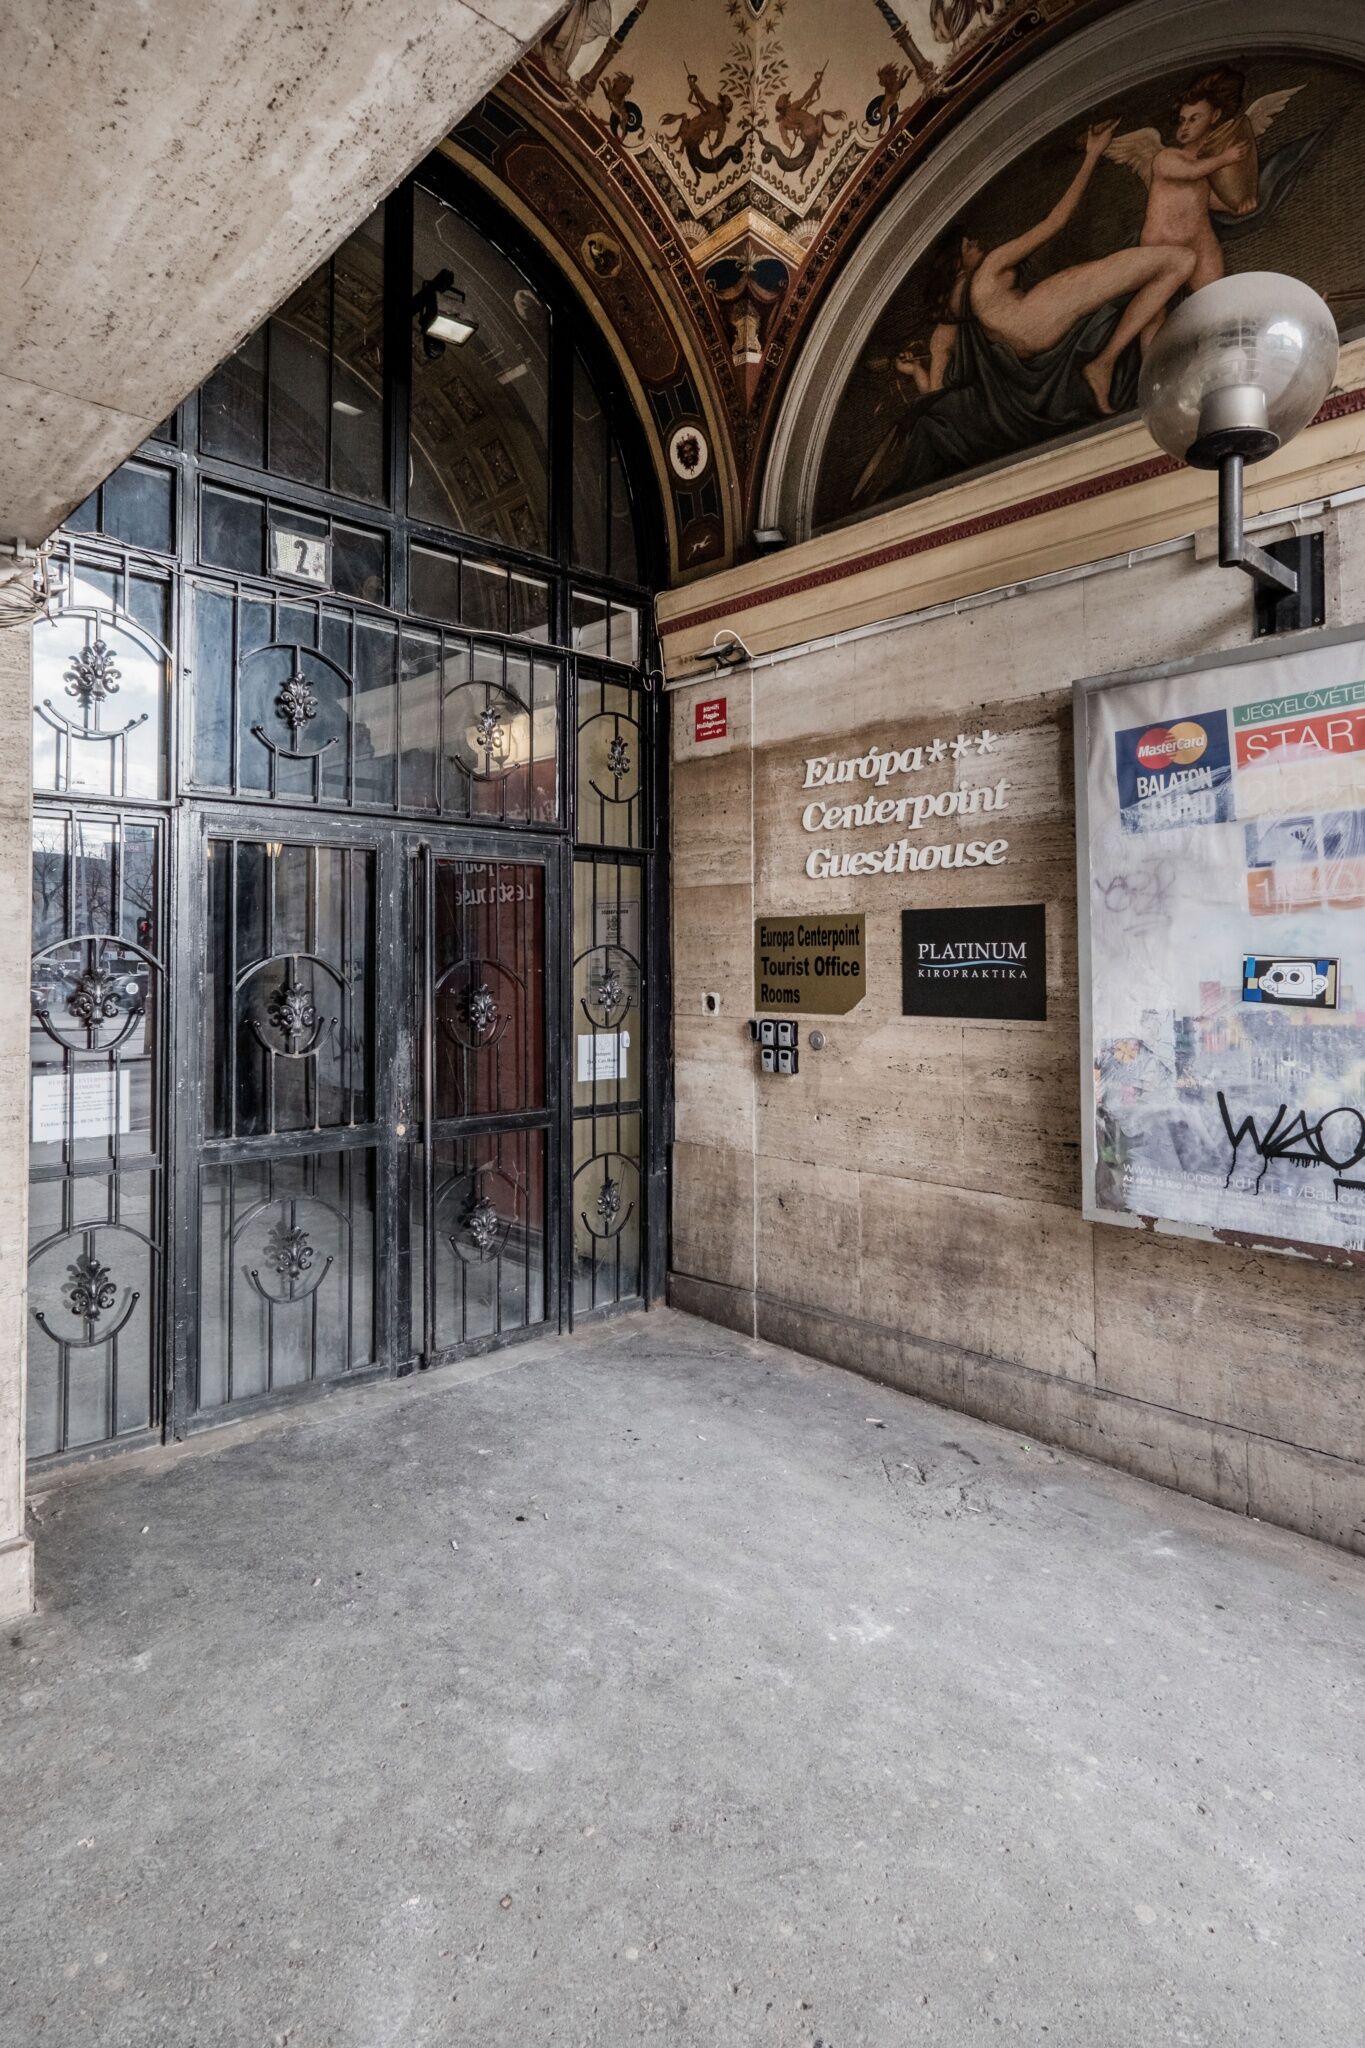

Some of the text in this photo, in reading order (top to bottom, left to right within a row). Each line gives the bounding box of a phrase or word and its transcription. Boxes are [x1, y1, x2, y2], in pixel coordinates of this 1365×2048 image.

[294, 540, 310, 576] 2
[1241, 684, 1365, 722] JEGYELŐVÉTE
[1137, 735, 1205, 758] MasterCard
[1136, 766, 1213, 798] BALATON
[802, 778, 1011, 833] Centerpoint
[805, 838, 1010, 880] Guesthouse
[760, 923, 860, 952] Europa Centerpoint
[917, 942, 1027, 960] PLATINUM
[761, 955, 860, 977] Tourist Office
[918, 969, 1028, 979] KIROPRAKTIKA
[761, 983, 801, 1004] Rooms
